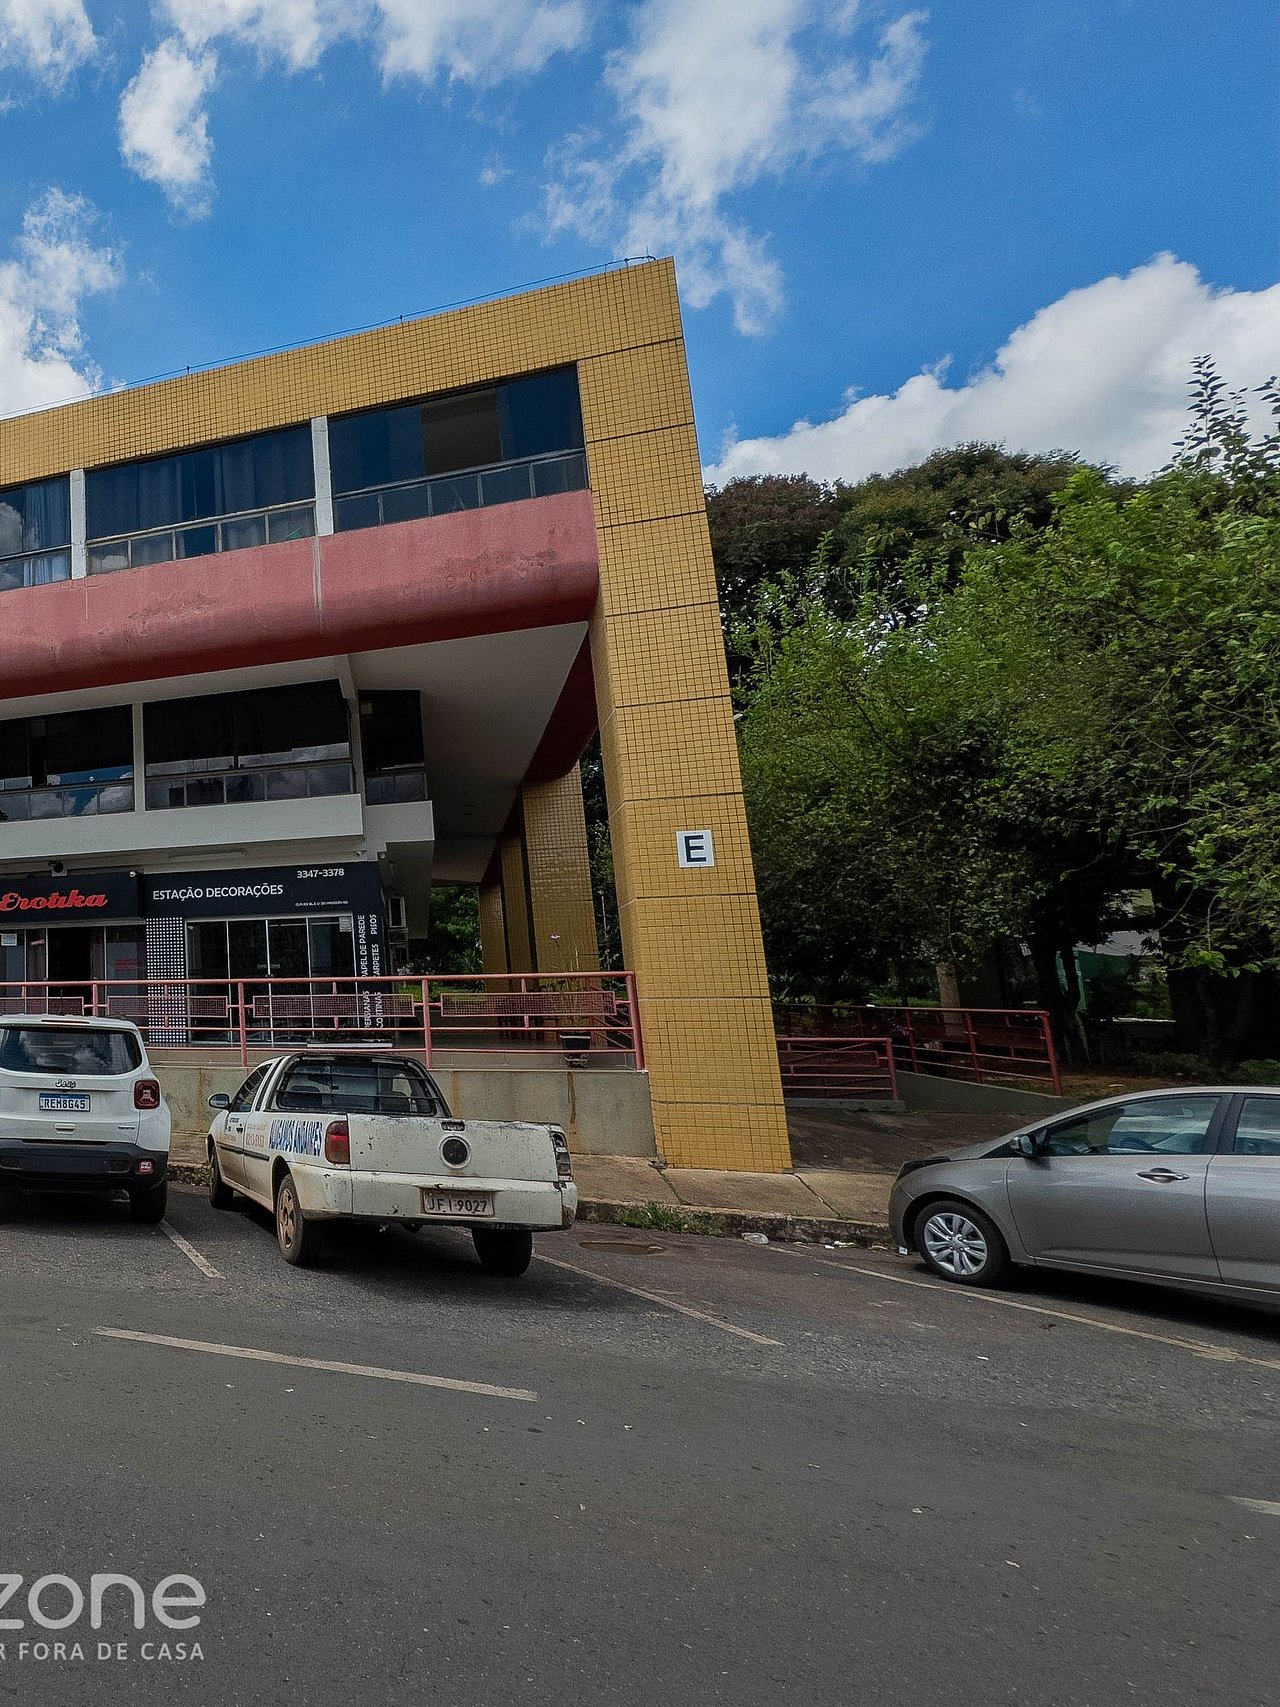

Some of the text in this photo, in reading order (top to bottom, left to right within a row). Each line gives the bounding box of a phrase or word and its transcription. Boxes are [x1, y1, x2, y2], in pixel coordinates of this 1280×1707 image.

[684, 834, 707, 862] E
[296, 868, 345, 879] 3347-3378
[152, 883, 283, 901] ESTAÇÃO DECORAÇÕES
[357, 914, 367, 944] PAREDE
[369, 914, 378, 935] PISOS
[359, 944, 367, 955] DE
[371, 943, 380, 978] ARPETES
